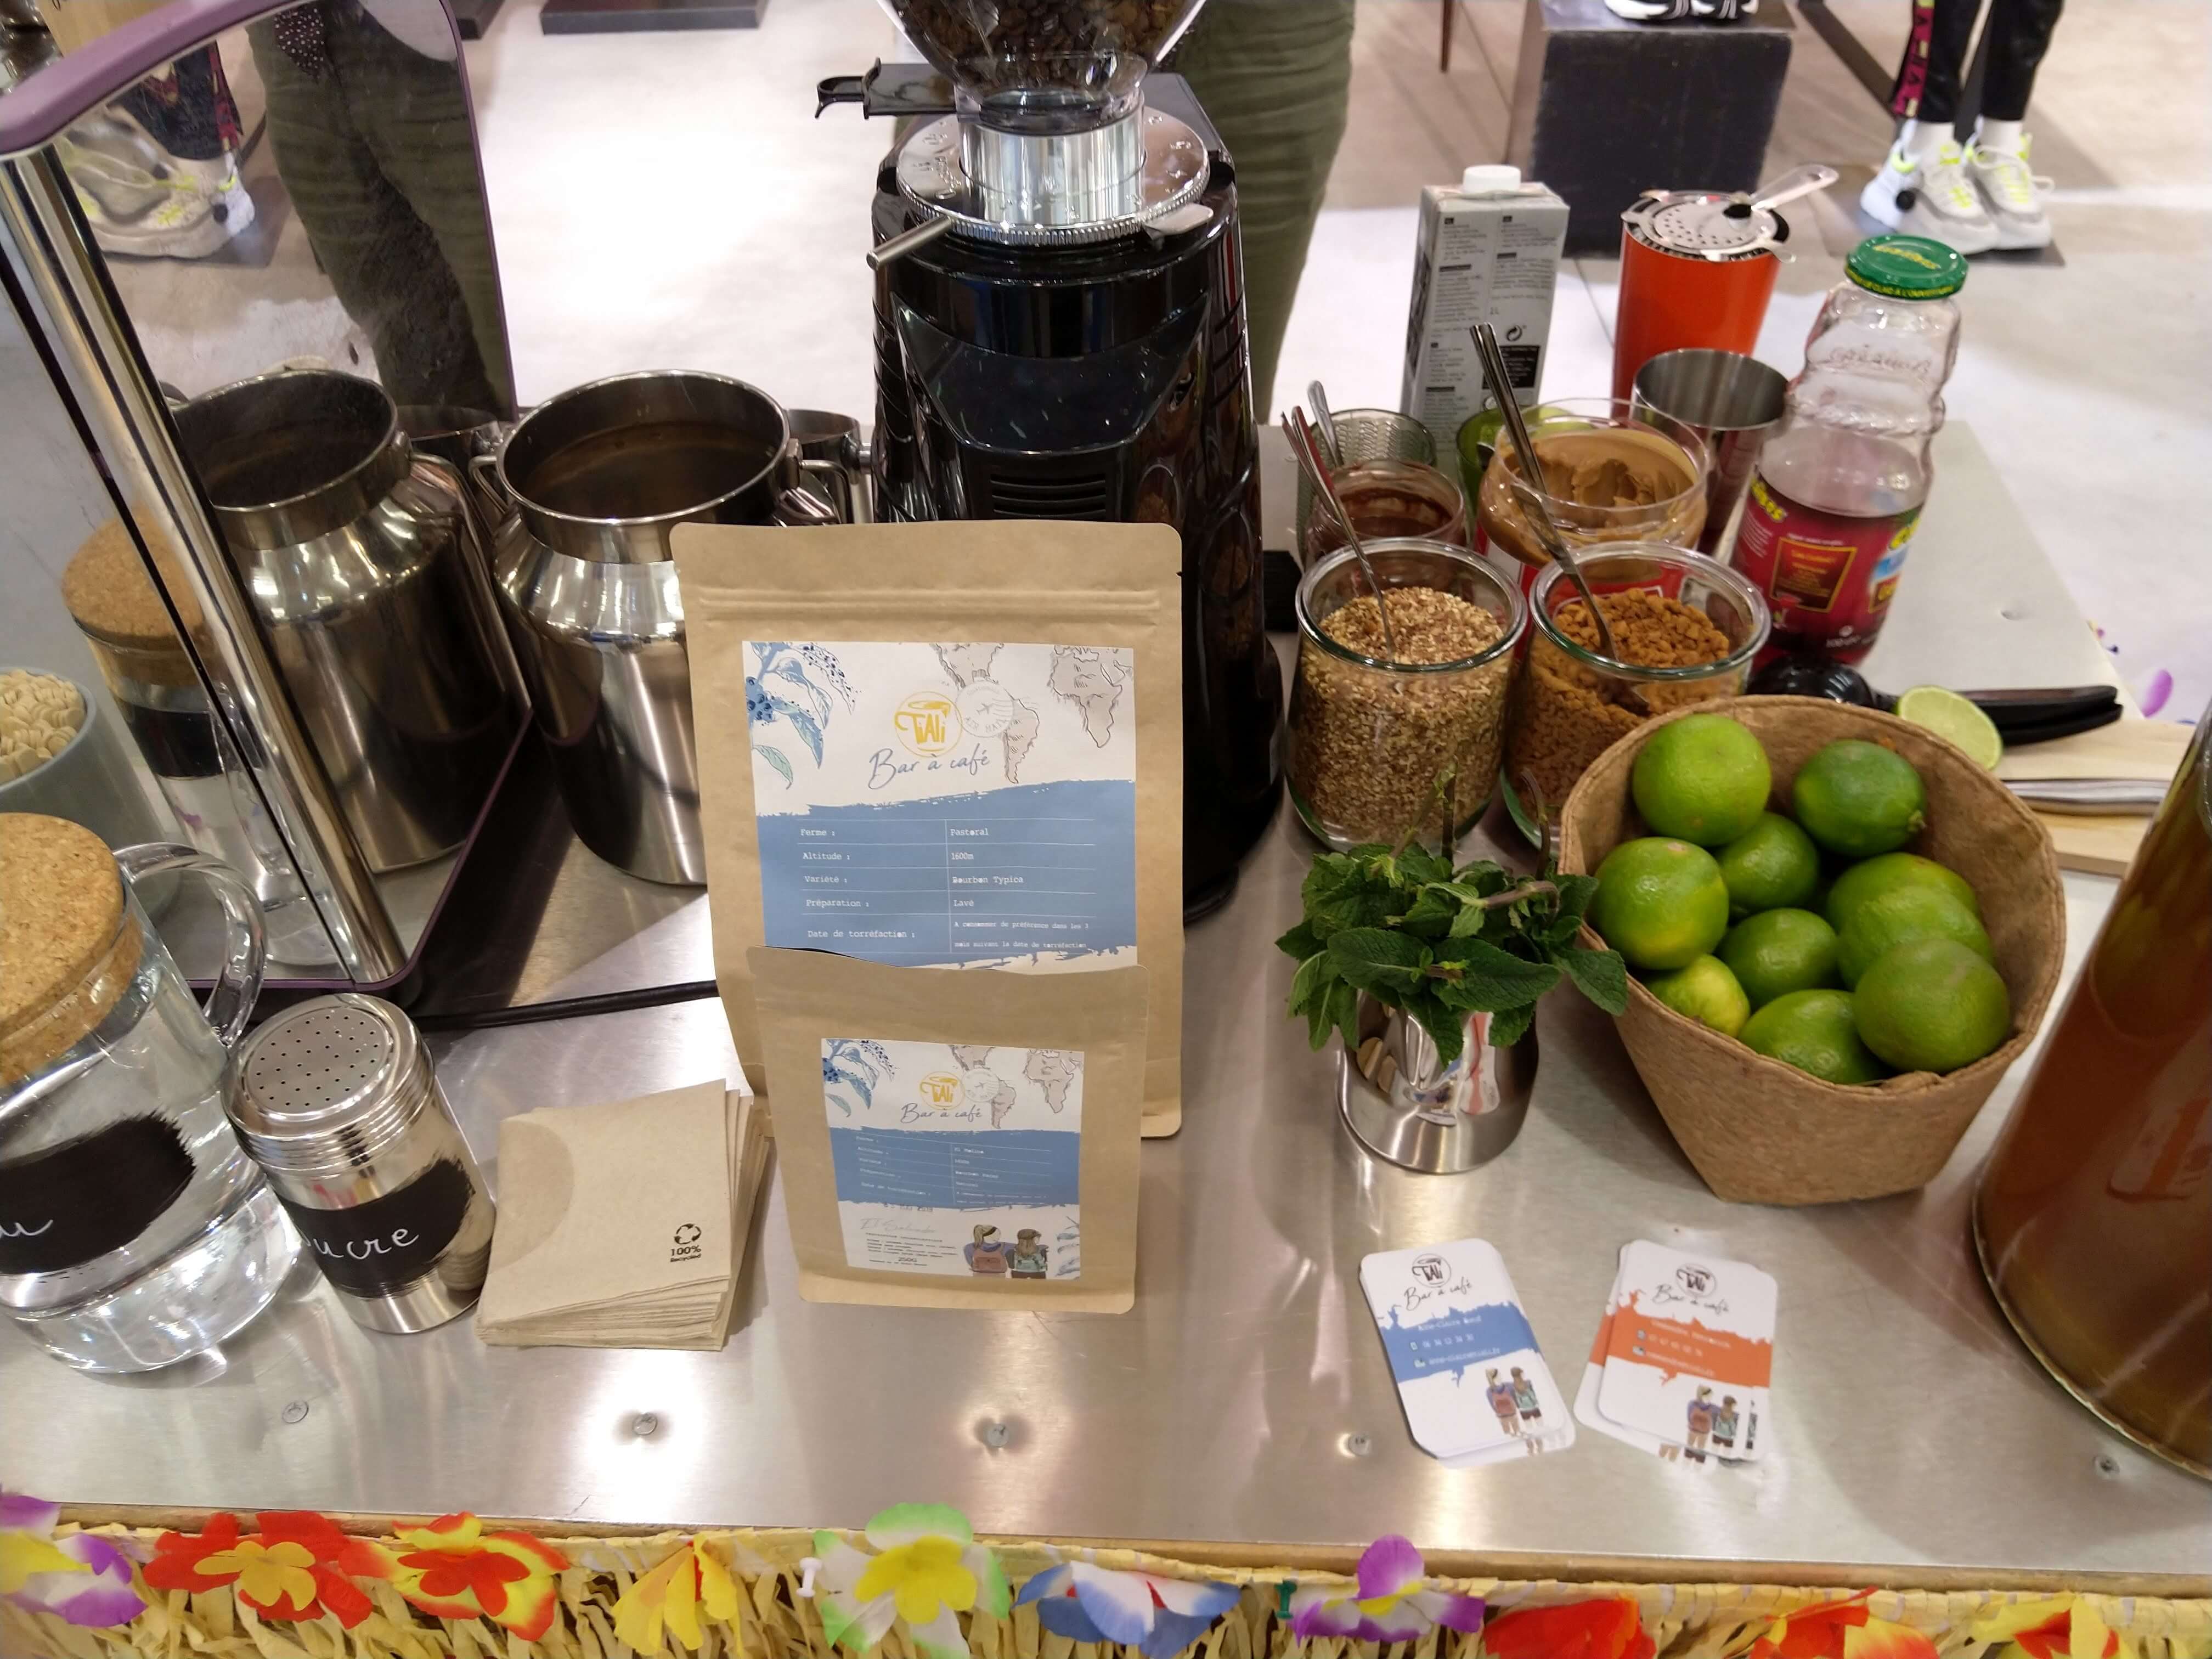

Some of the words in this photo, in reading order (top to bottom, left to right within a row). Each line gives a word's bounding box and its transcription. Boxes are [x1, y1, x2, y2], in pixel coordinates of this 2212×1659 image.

[868, 748, 919, 789] Bar
[928, 753, 941, 770] à
[950, 743, 990, 776] café
[800, 828, 827, 837] Ferme
[950, 827, 989, 837] Pastoral
[803, 852, 842, 861] Altitude
[951, 852, 974, 861] 1600m
[992, 876, 1024, 885] Typica
[805, 899, 861, 909] Préparation
[807, 930, 828, 938] Date
[833, 929, 844, 938] de
[900, 1103, 935, 1124] Bar
[955, 1104, 983, 1122] café
[671, 1245, 702, 1256] 100%
[1404, 1286, 1432, 1311] Bar
[1449, 1276, 1472, 1295] café
